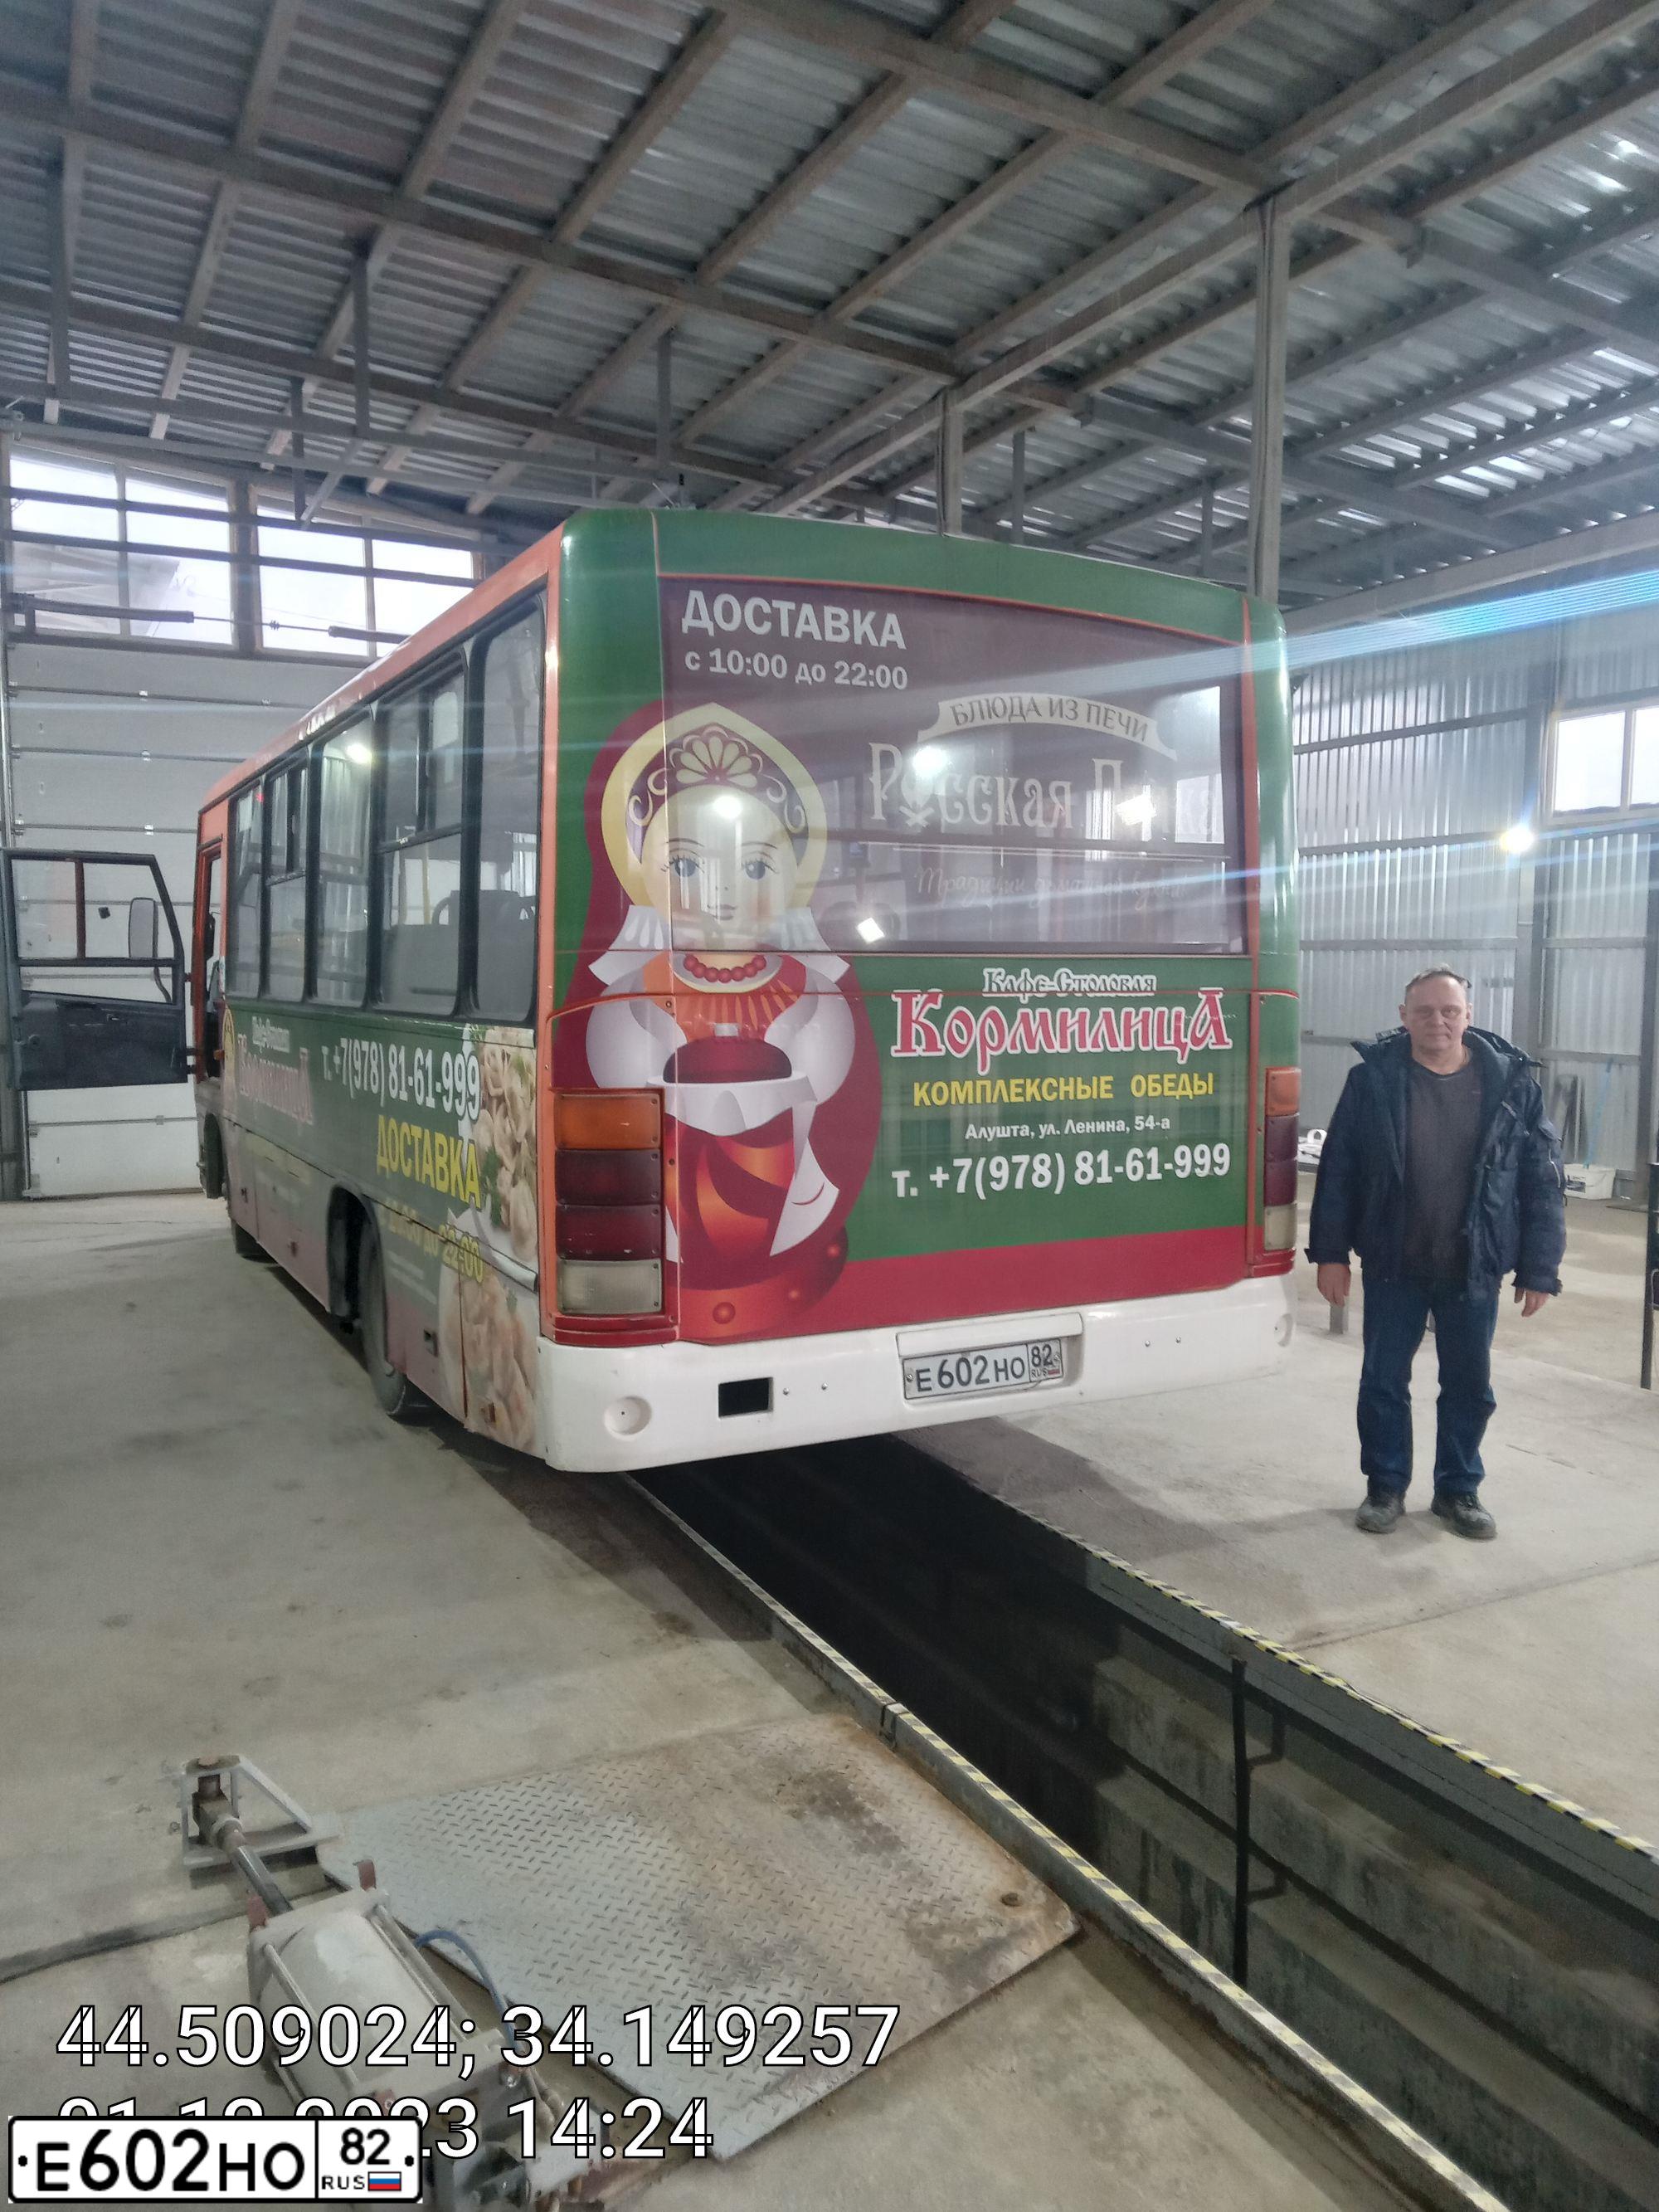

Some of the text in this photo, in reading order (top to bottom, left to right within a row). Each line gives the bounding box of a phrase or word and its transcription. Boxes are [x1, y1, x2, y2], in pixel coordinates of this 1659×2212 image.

[682, 590, 907, 650] ДОСТАВКА
[685, 648, 907, 689] с 10:00 до 22:00
[950, 696, 1148, 743] БЛЮДА ИЗ ПЕЧИ
[333, 1037, 385, 1108] +7(978)
[388, 1043, 481, 1121] 81-61-999
[913, 1073, 1214, 1107] КОМПЛЕКСНЫЕ ОБЕДЫ
[965, 1115, 1170, 1142] Алушта, ул. Ленина, 54-а
[377, 1113, 482, 1209] ДОСТАВКА
[929, 1152, 1067, 1201] +7(978)
[1074, 1143, 1231, 1186] 81-61-999
[916, 1344, 1053, 1392] Е602НО 82
